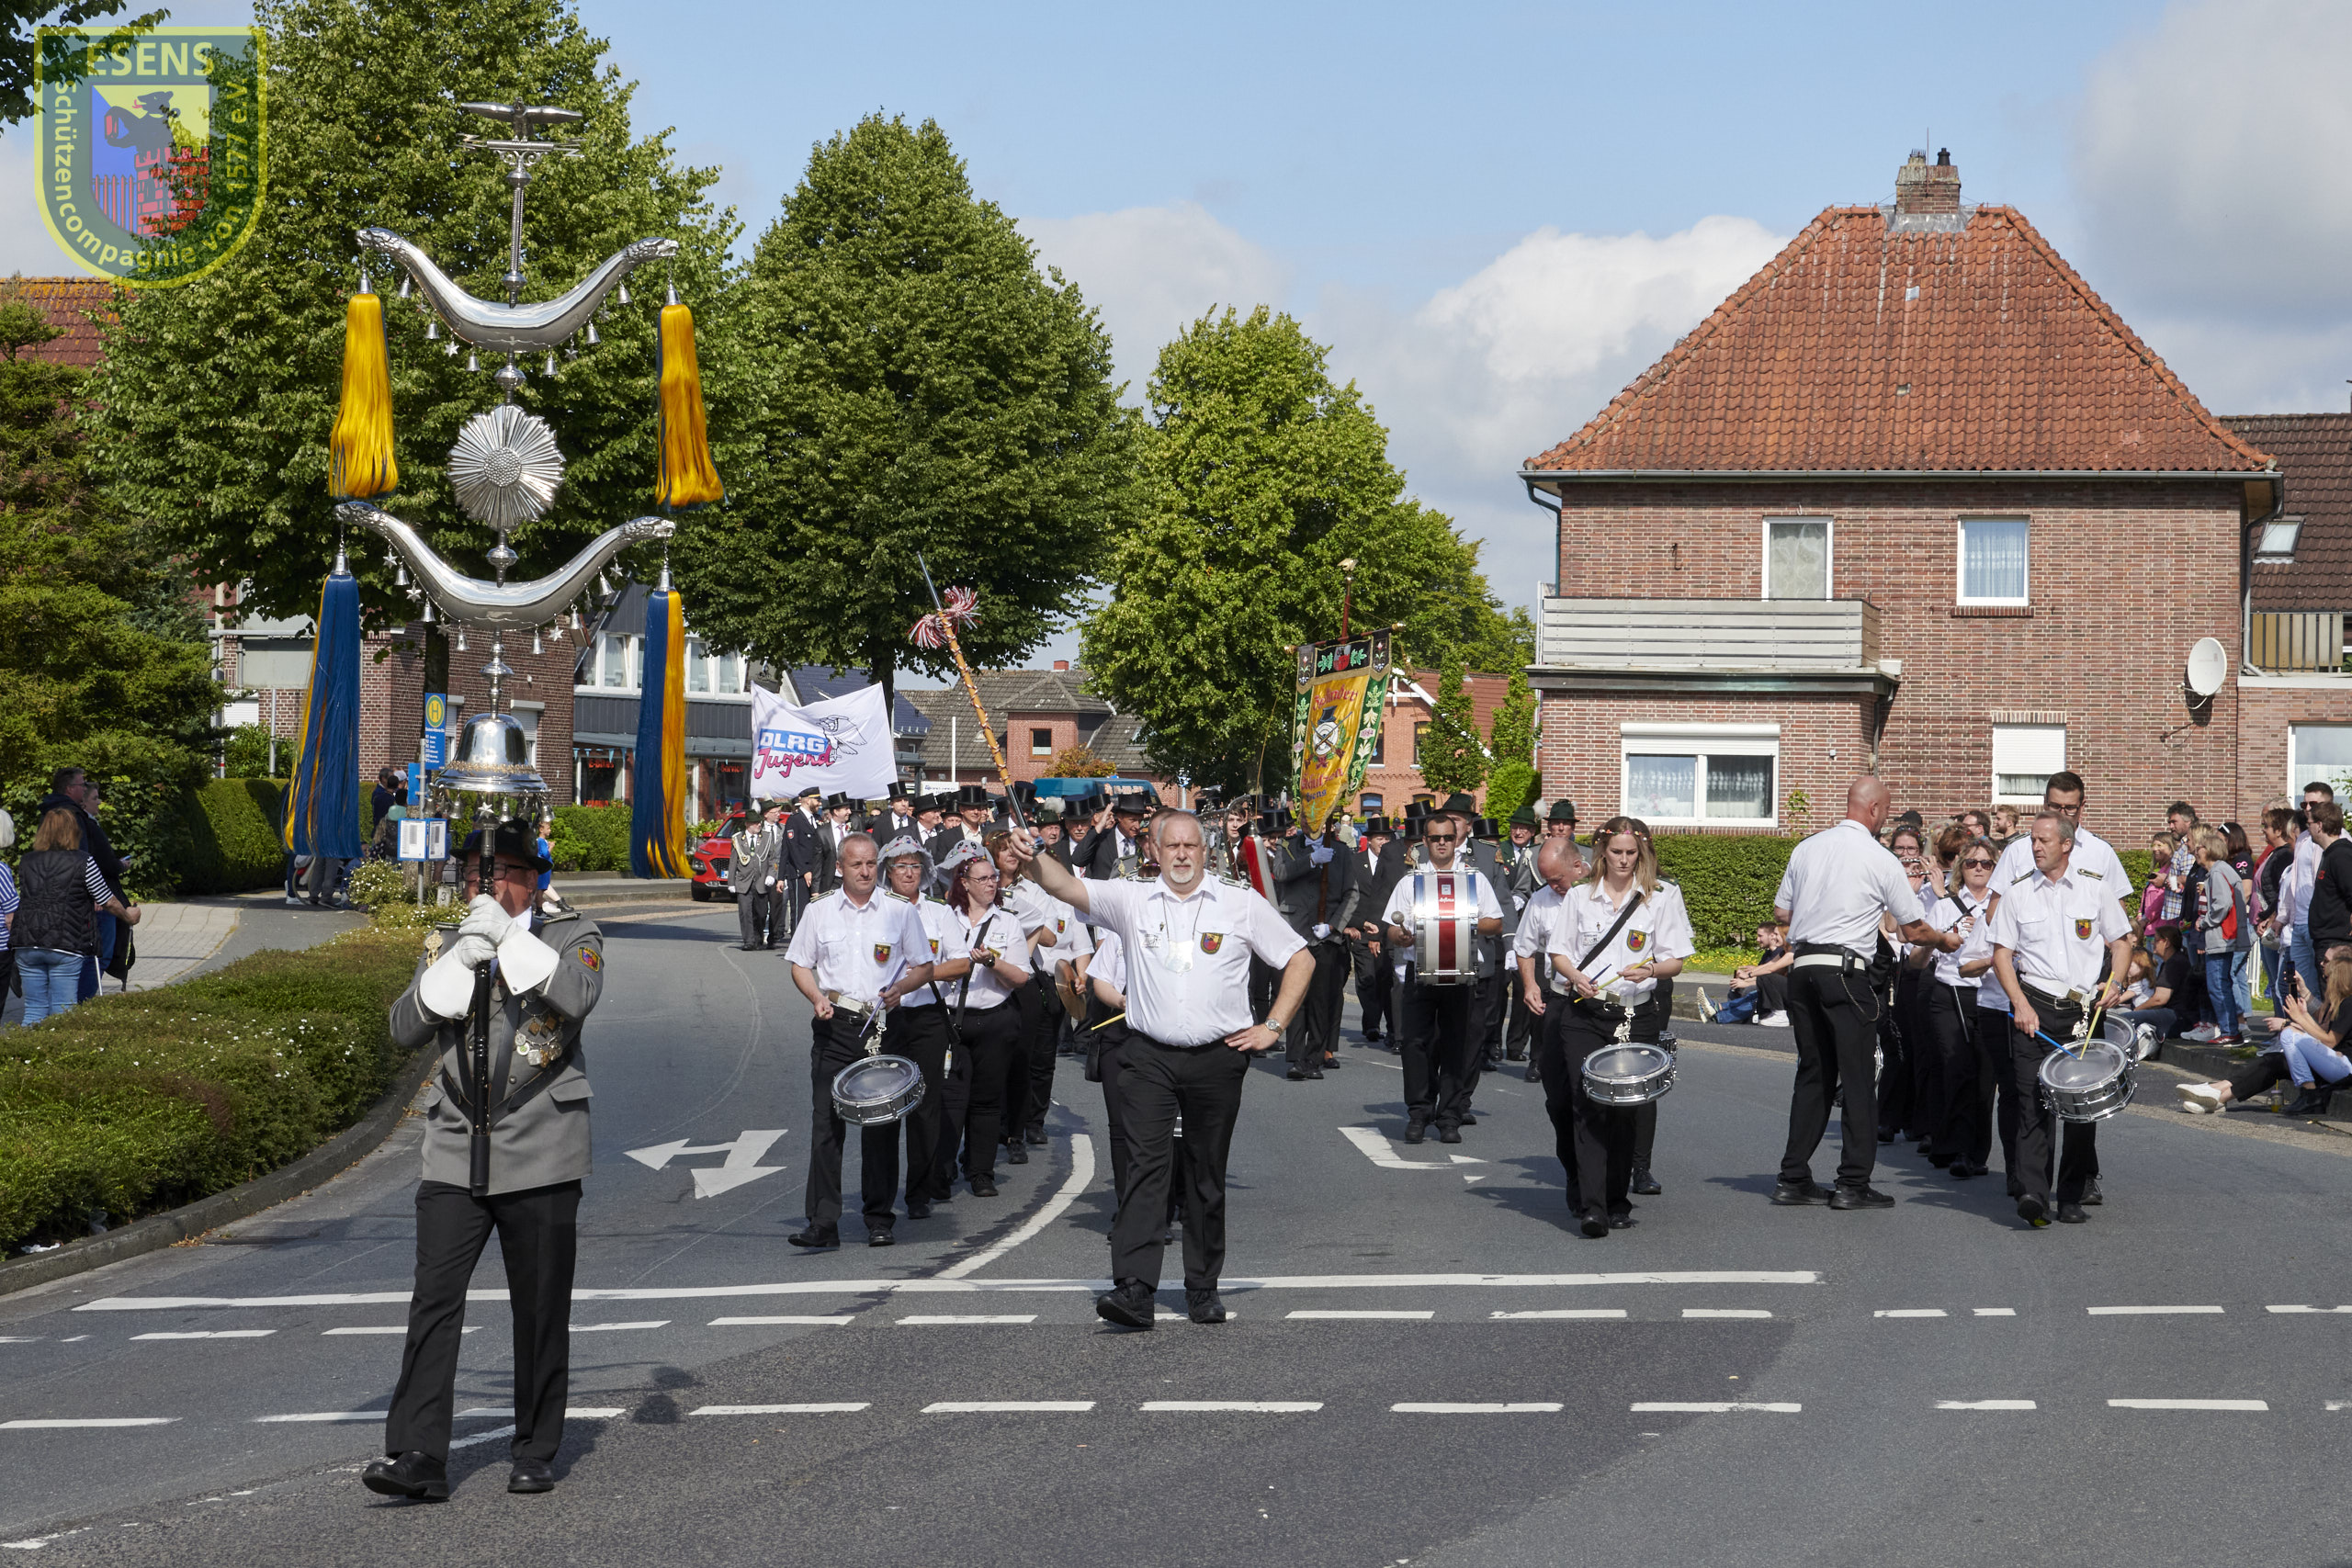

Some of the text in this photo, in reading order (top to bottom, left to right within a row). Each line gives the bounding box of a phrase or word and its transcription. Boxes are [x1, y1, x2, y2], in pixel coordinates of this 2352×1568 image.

[759, 731, 826, 753] DLRG
[753, 744, 836, 779] Jugend
[440, 891, 447, 902] 3
